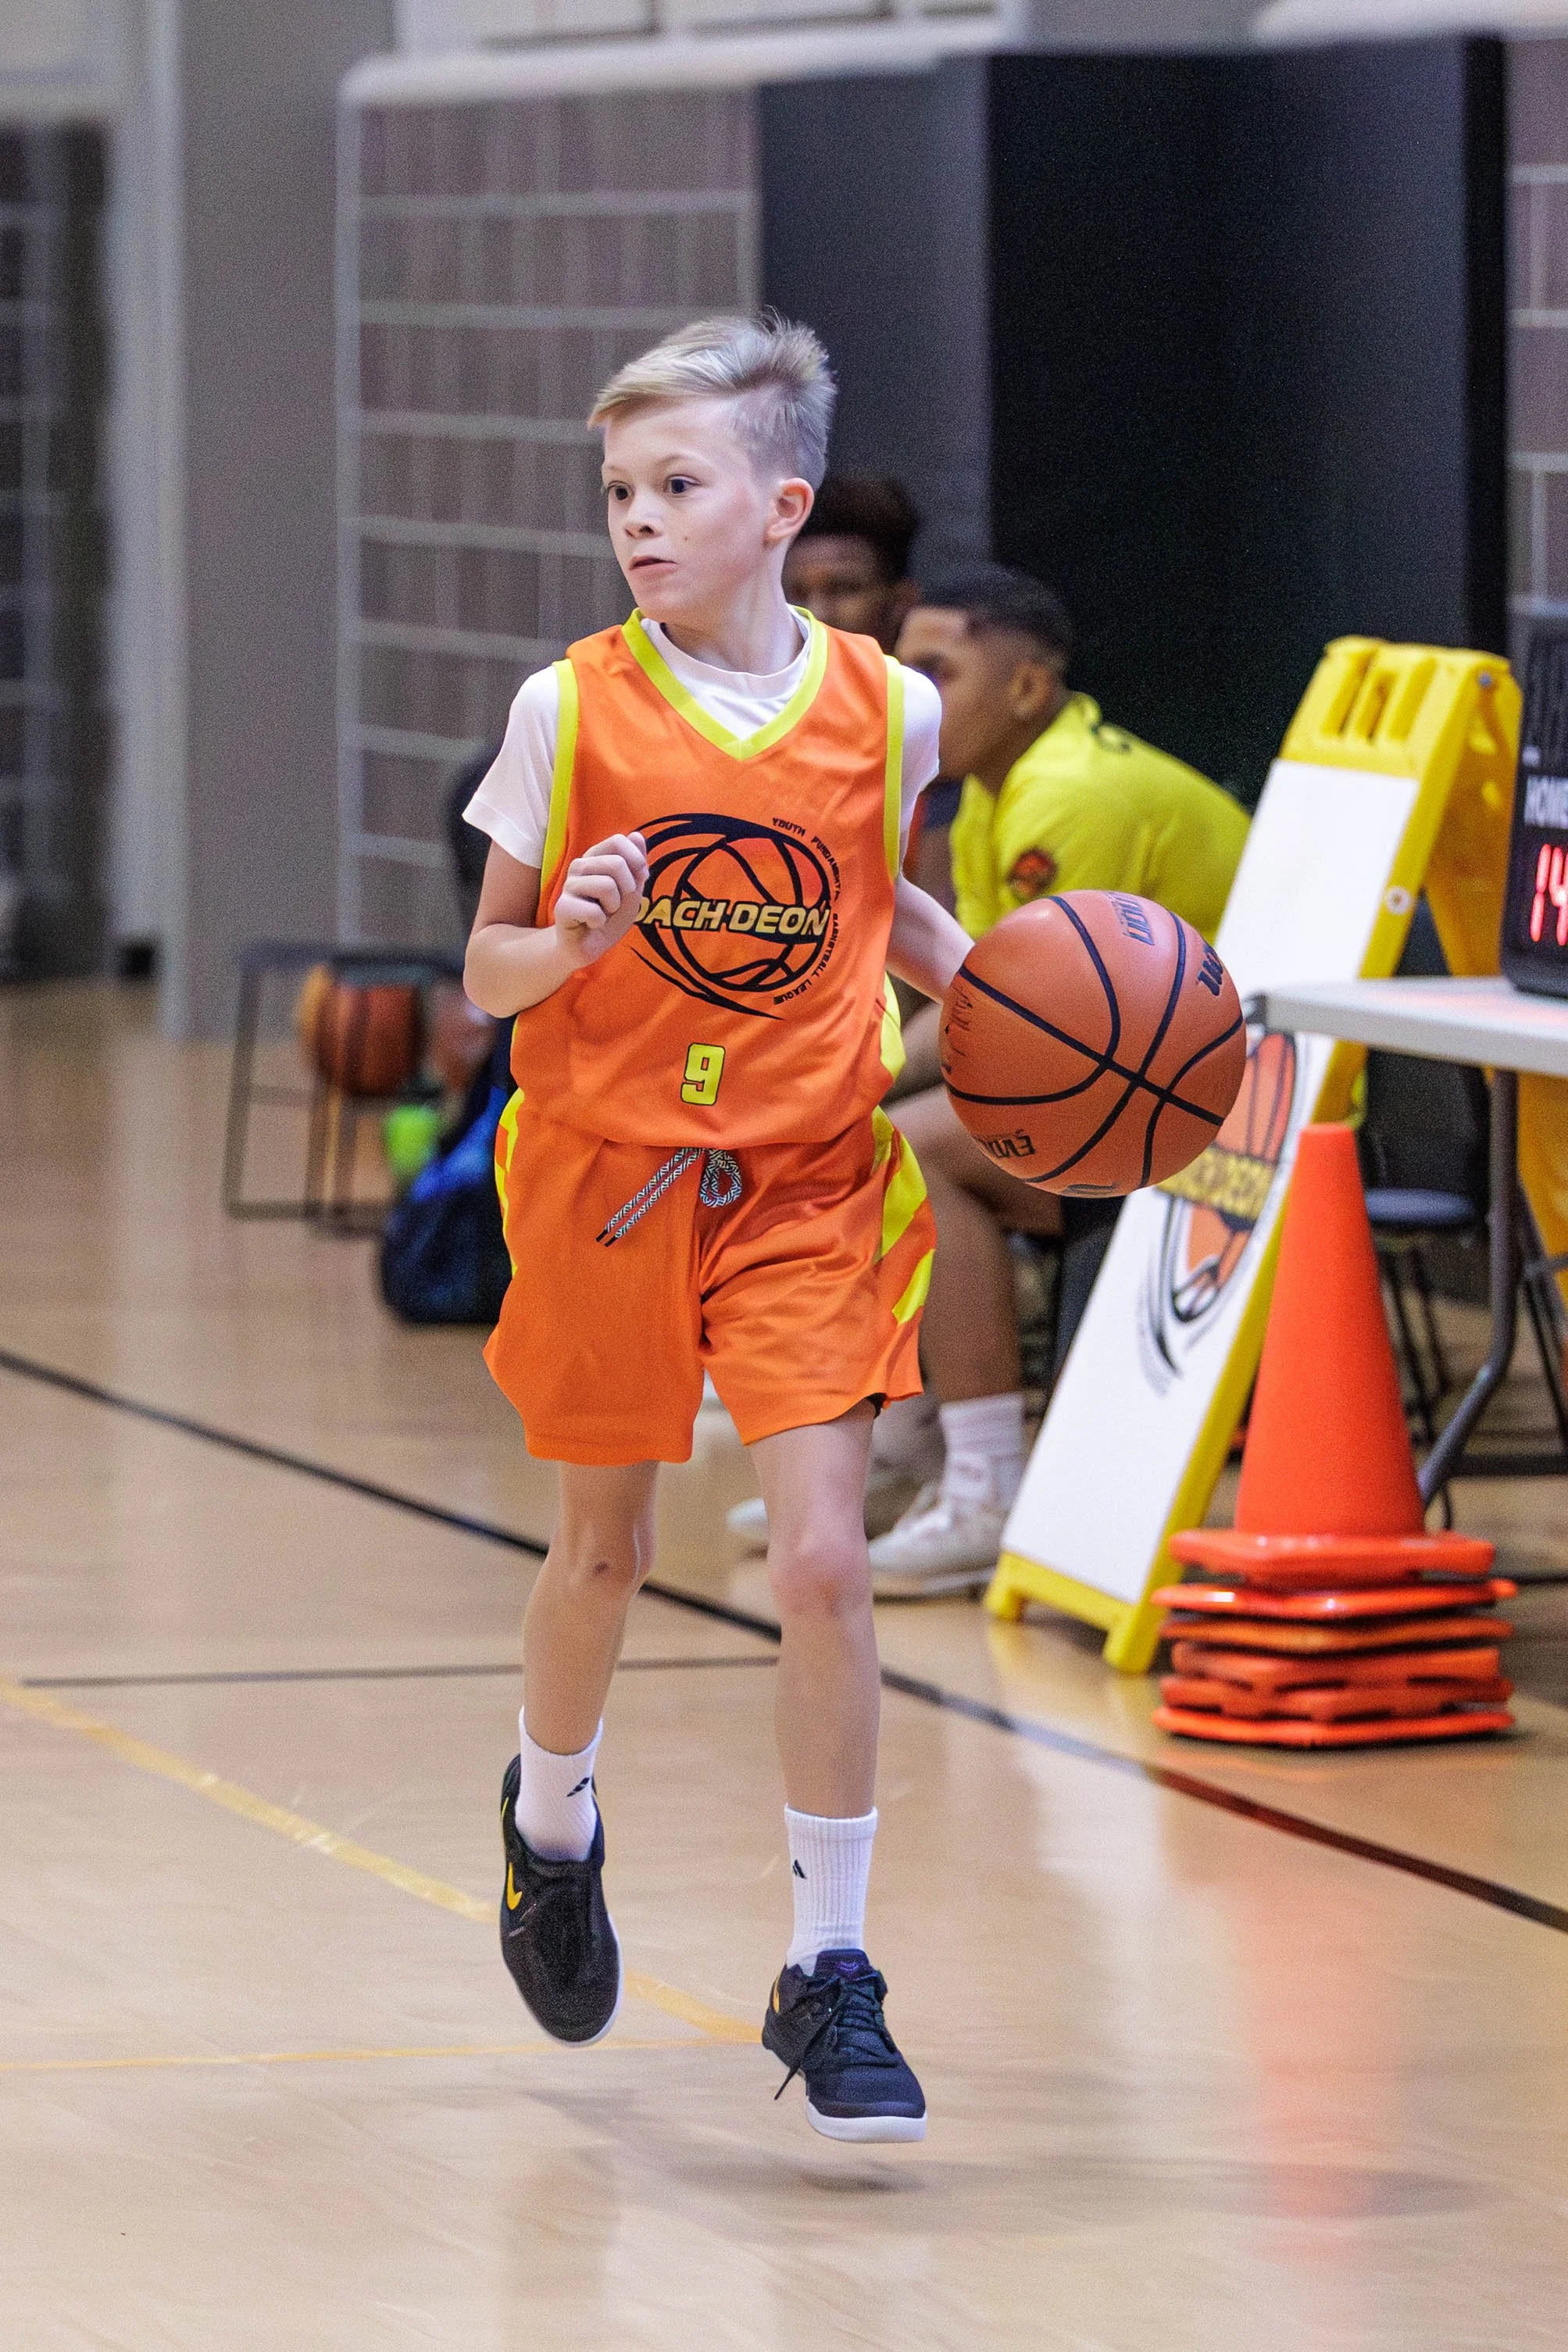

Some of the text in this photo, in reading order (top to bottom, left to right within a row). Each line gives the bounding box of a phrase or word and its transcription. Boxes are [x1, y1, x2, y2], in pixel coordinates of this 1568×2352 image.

[772, 817, 806, 838] YOUTH
[727, 903, 831, 937] DEON
[680, 1042, 726, 1106] 9
